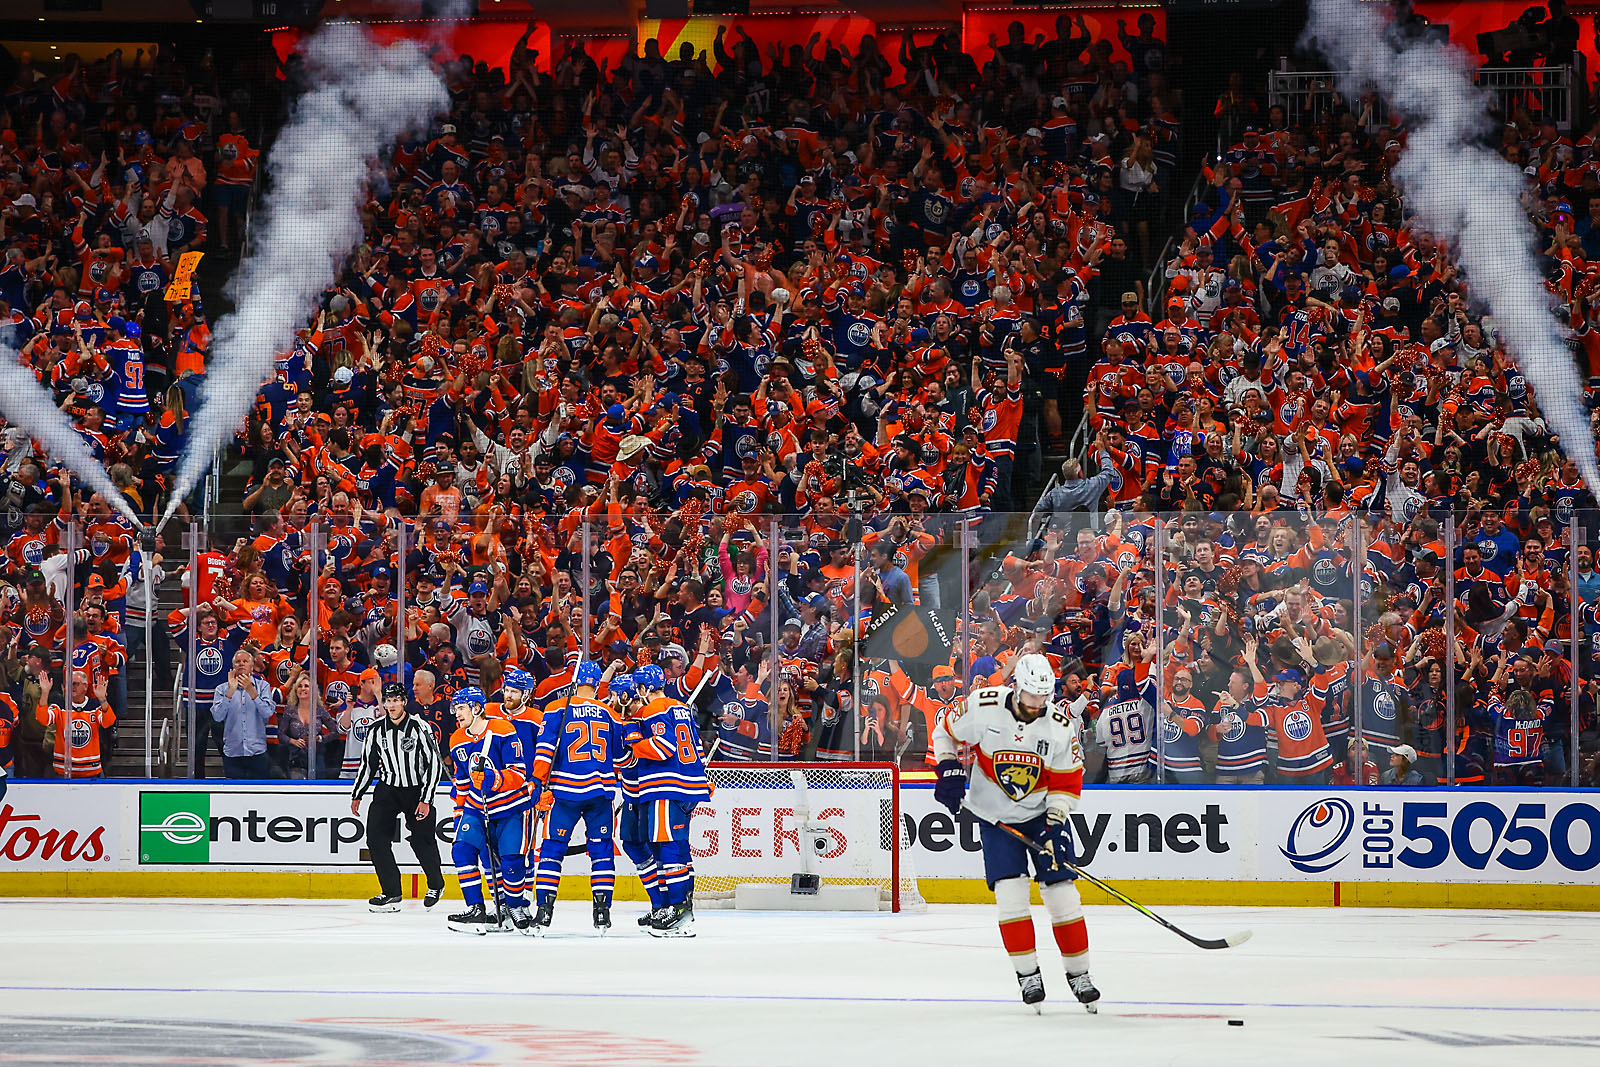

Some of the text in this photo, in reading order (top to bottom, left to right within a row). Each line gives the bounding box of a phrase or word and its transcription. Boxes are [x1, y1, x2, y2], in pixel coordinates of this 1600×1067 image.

[1285, 320, 1310, 349] 14
[870, 604, 899, 631] DEADLY
[572, 706, 603, 718] NURSE
[979, 690, 999, 707] 91
[1108, 701, 1139, 717] GRETZKY
[566, 720, 610, 763] 25
[1110, 713, 1145, 748] 99
[1508, 728, 1544, 757] 97
[997, 754, 1037, 764] FLORIDA
[1363, 802, 1394, 868] EOCF
[1396, 801, 1600, 872] 5050
